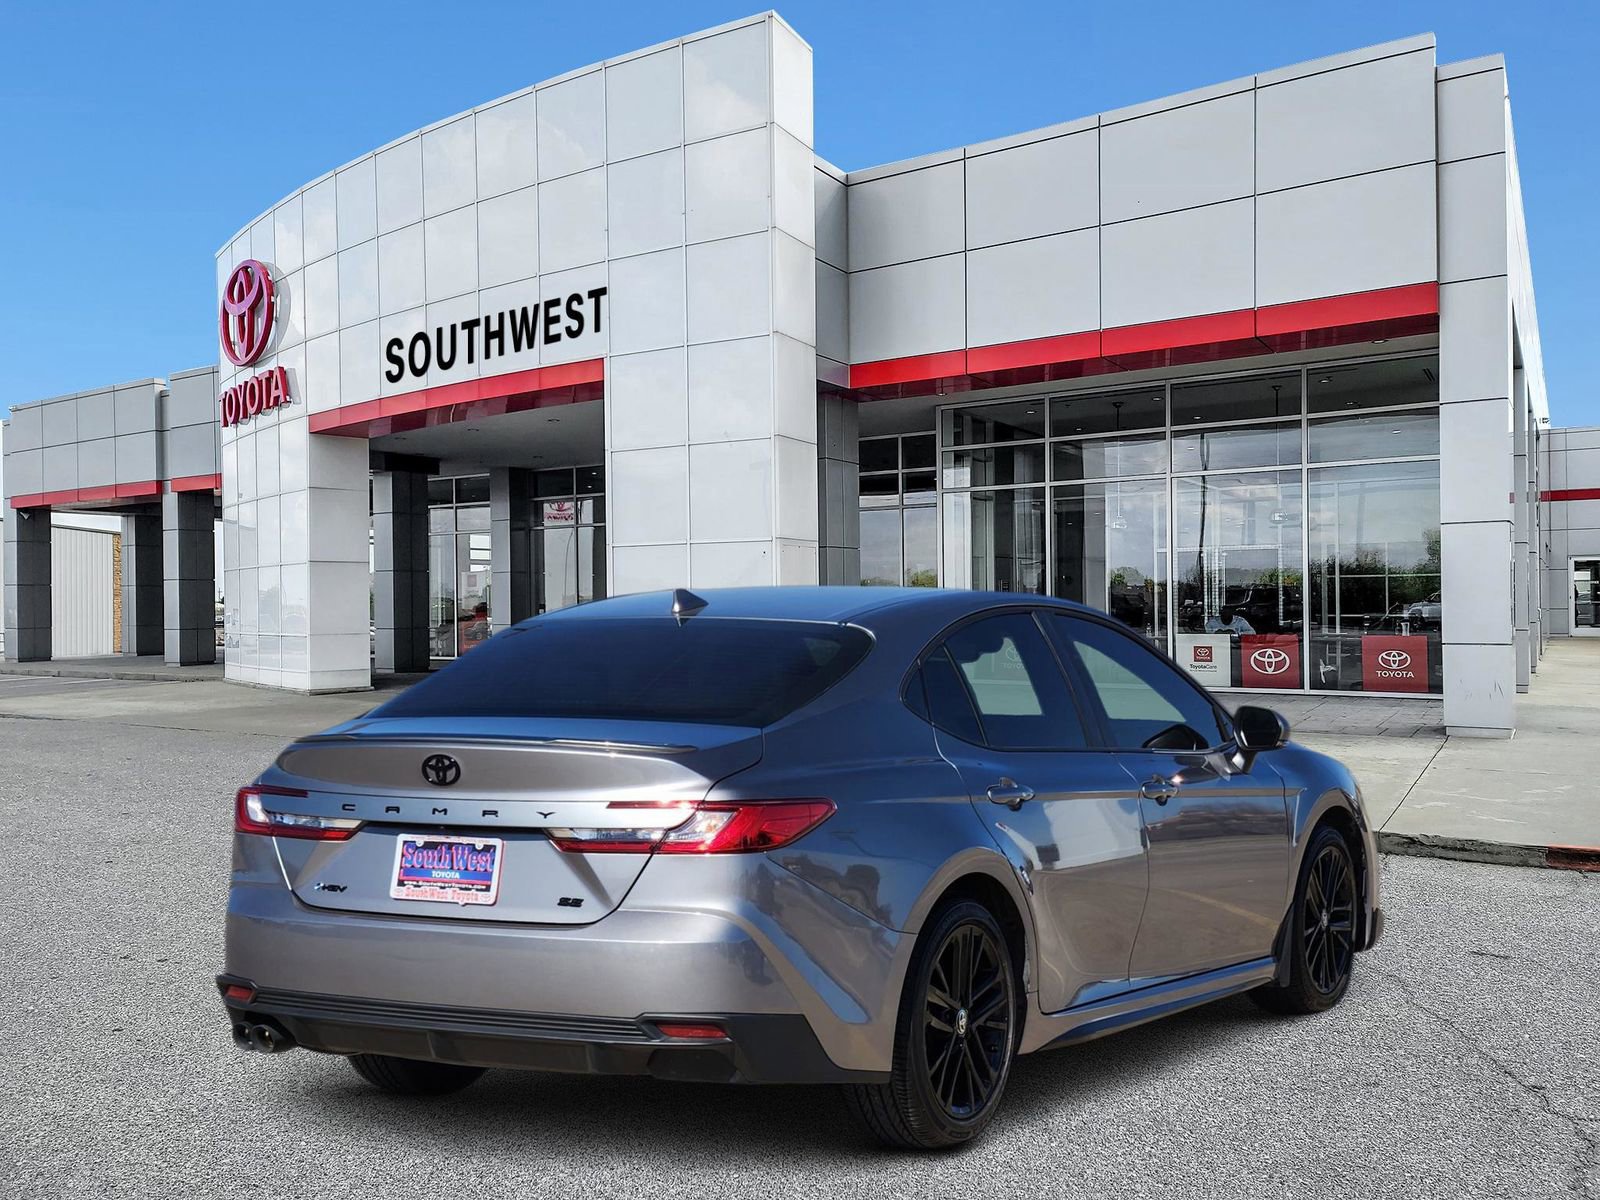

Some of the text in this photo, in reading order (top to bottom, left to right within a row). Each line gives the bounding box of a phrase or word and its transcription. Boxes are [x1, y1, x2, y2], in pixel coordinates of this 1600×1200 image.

[385, 286, 608, 384] SOUTHWEST
[218, 366, 290, 428] TOYOTA
[1375, 670, 1415, 678] TOYOTA
[341, 803, 557, 819] CAMRY
[432, 871, 460, 879] TOYOTA
[557, 897, 585, 908] SE
